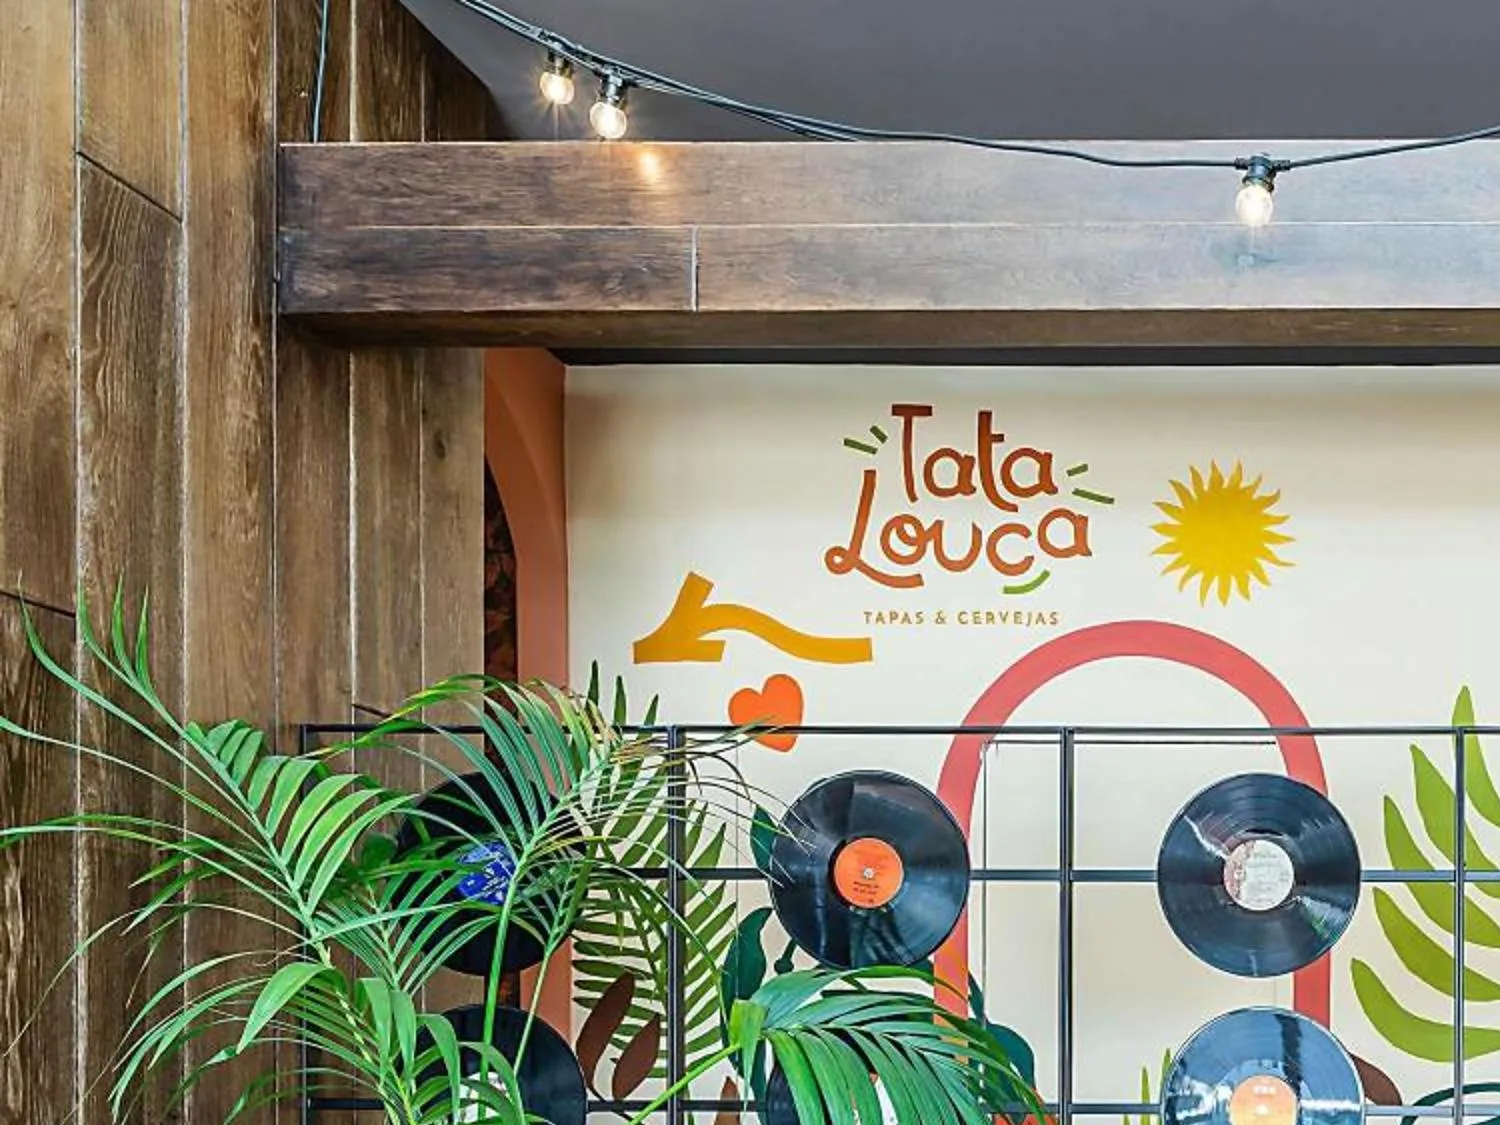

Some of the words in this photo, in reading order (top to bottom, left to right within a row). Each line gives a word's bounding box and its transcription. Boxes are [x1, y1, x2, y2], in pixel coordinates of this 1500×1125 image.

[891, 404, 1058, 512] Tata
[824, 469, 1092, 594] Louça
[863, 611, 924, 625] TAPAS
[935, 611, 947, 625] &
[957, 611, 1060, 627] CERVEJAS
